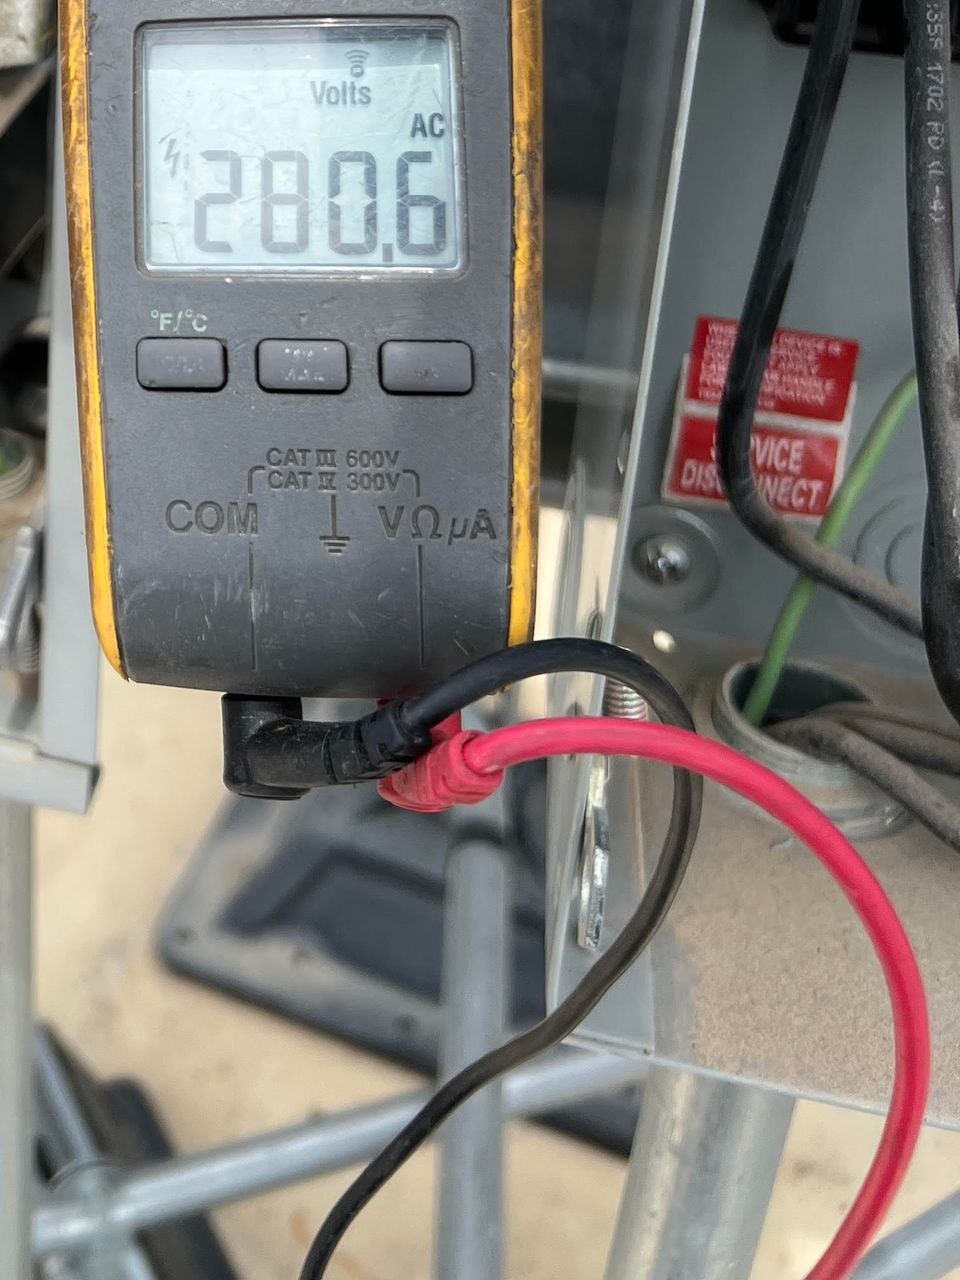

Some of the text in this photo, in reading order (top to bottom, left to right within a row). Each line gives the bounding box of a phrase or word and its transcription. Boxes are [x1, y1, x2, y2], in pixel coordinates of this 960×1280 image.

[310, 80, 372, 106] Volts
[925, 62, 943, 112] 1702
[410, 113, 445, 138] AC
[194, 150, 447, 263] 280.6
[265, 448, 310, 467] CAT
[345, 450, 400, 468] 600V
[268, 472, 312, 490] CAT
[346, 473, 401, 491] 300V
[165, 500, 259, 535] COM
[378, 505, 405, 540] V
